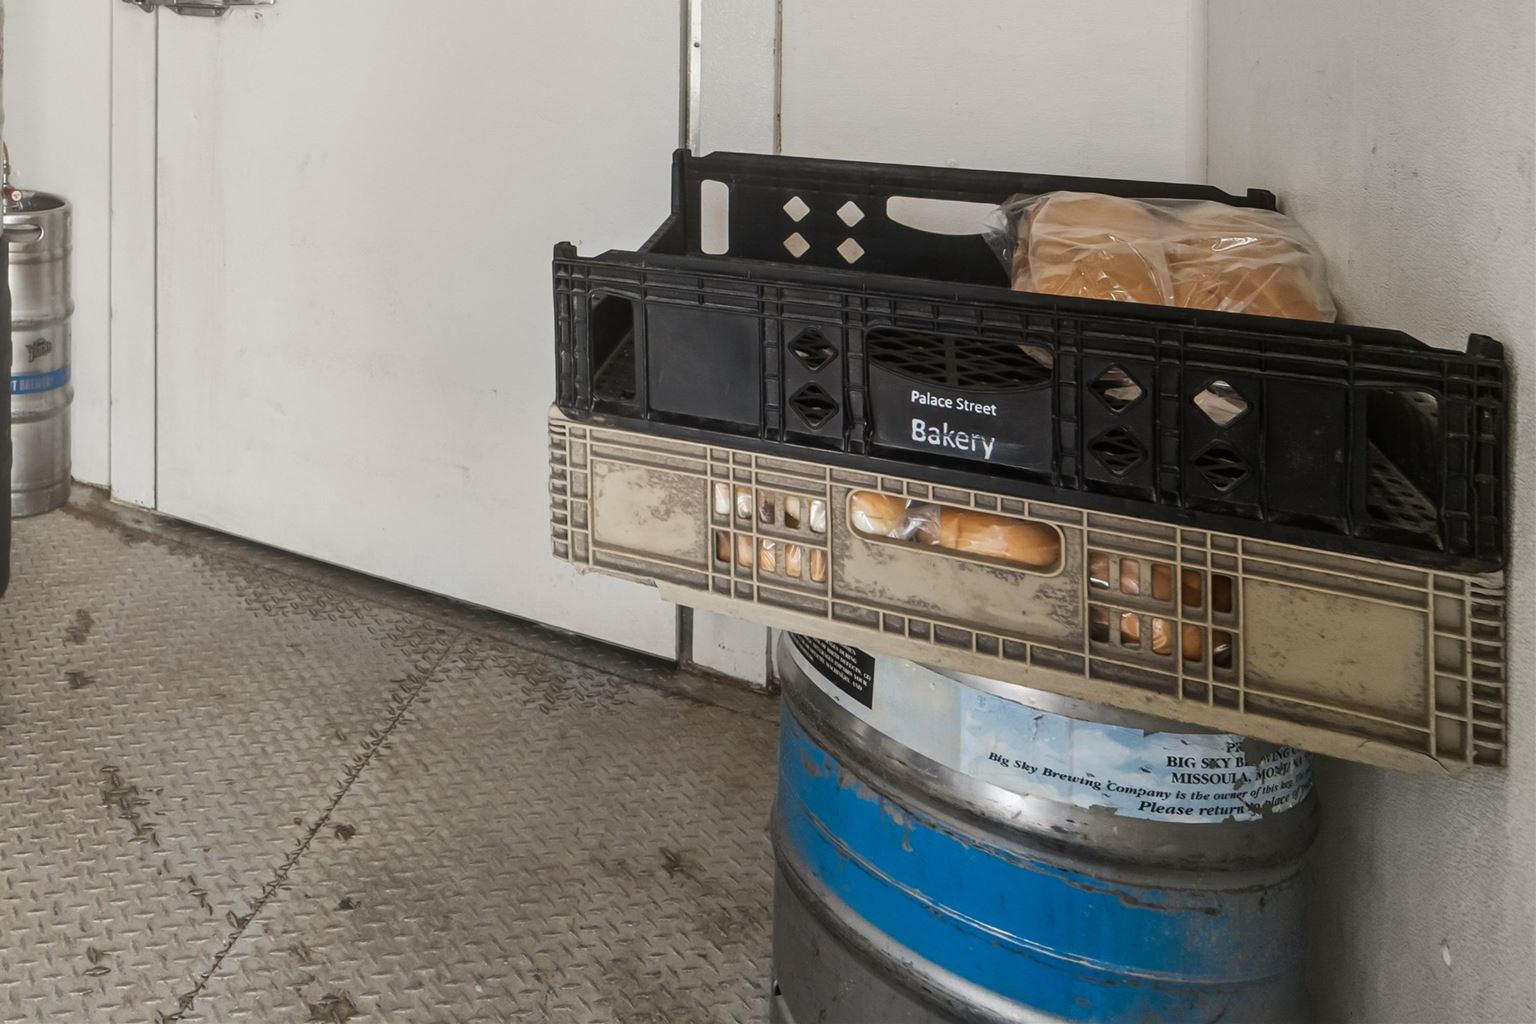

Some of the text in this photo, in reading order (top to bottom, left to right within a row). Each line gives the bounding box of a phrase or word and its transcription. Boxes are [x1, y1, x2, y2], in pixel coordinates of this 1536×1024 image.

[910, 390, 997, 417] Palace Street
[910, 418, 996, 460] Bakery
[1167, 756, 1196, 768] BIG
[988, 751, 1010, 768] Big
[1013, 759, 1038, 775] Sky
[1042, 767, 1102, 791] Brewing
[1106, 780, 1172, 801] Company
[1175, 790, 1188, 800] is
[1190, 790, 1210, 801] the
[1213, 790, 1248, 801] owner
[1250, 786, 1262, 799] of
[1262, 782, 1279, 794] this
[1138, 800, 1194, 816] Please
[1199, 805, 1244, 816] return
